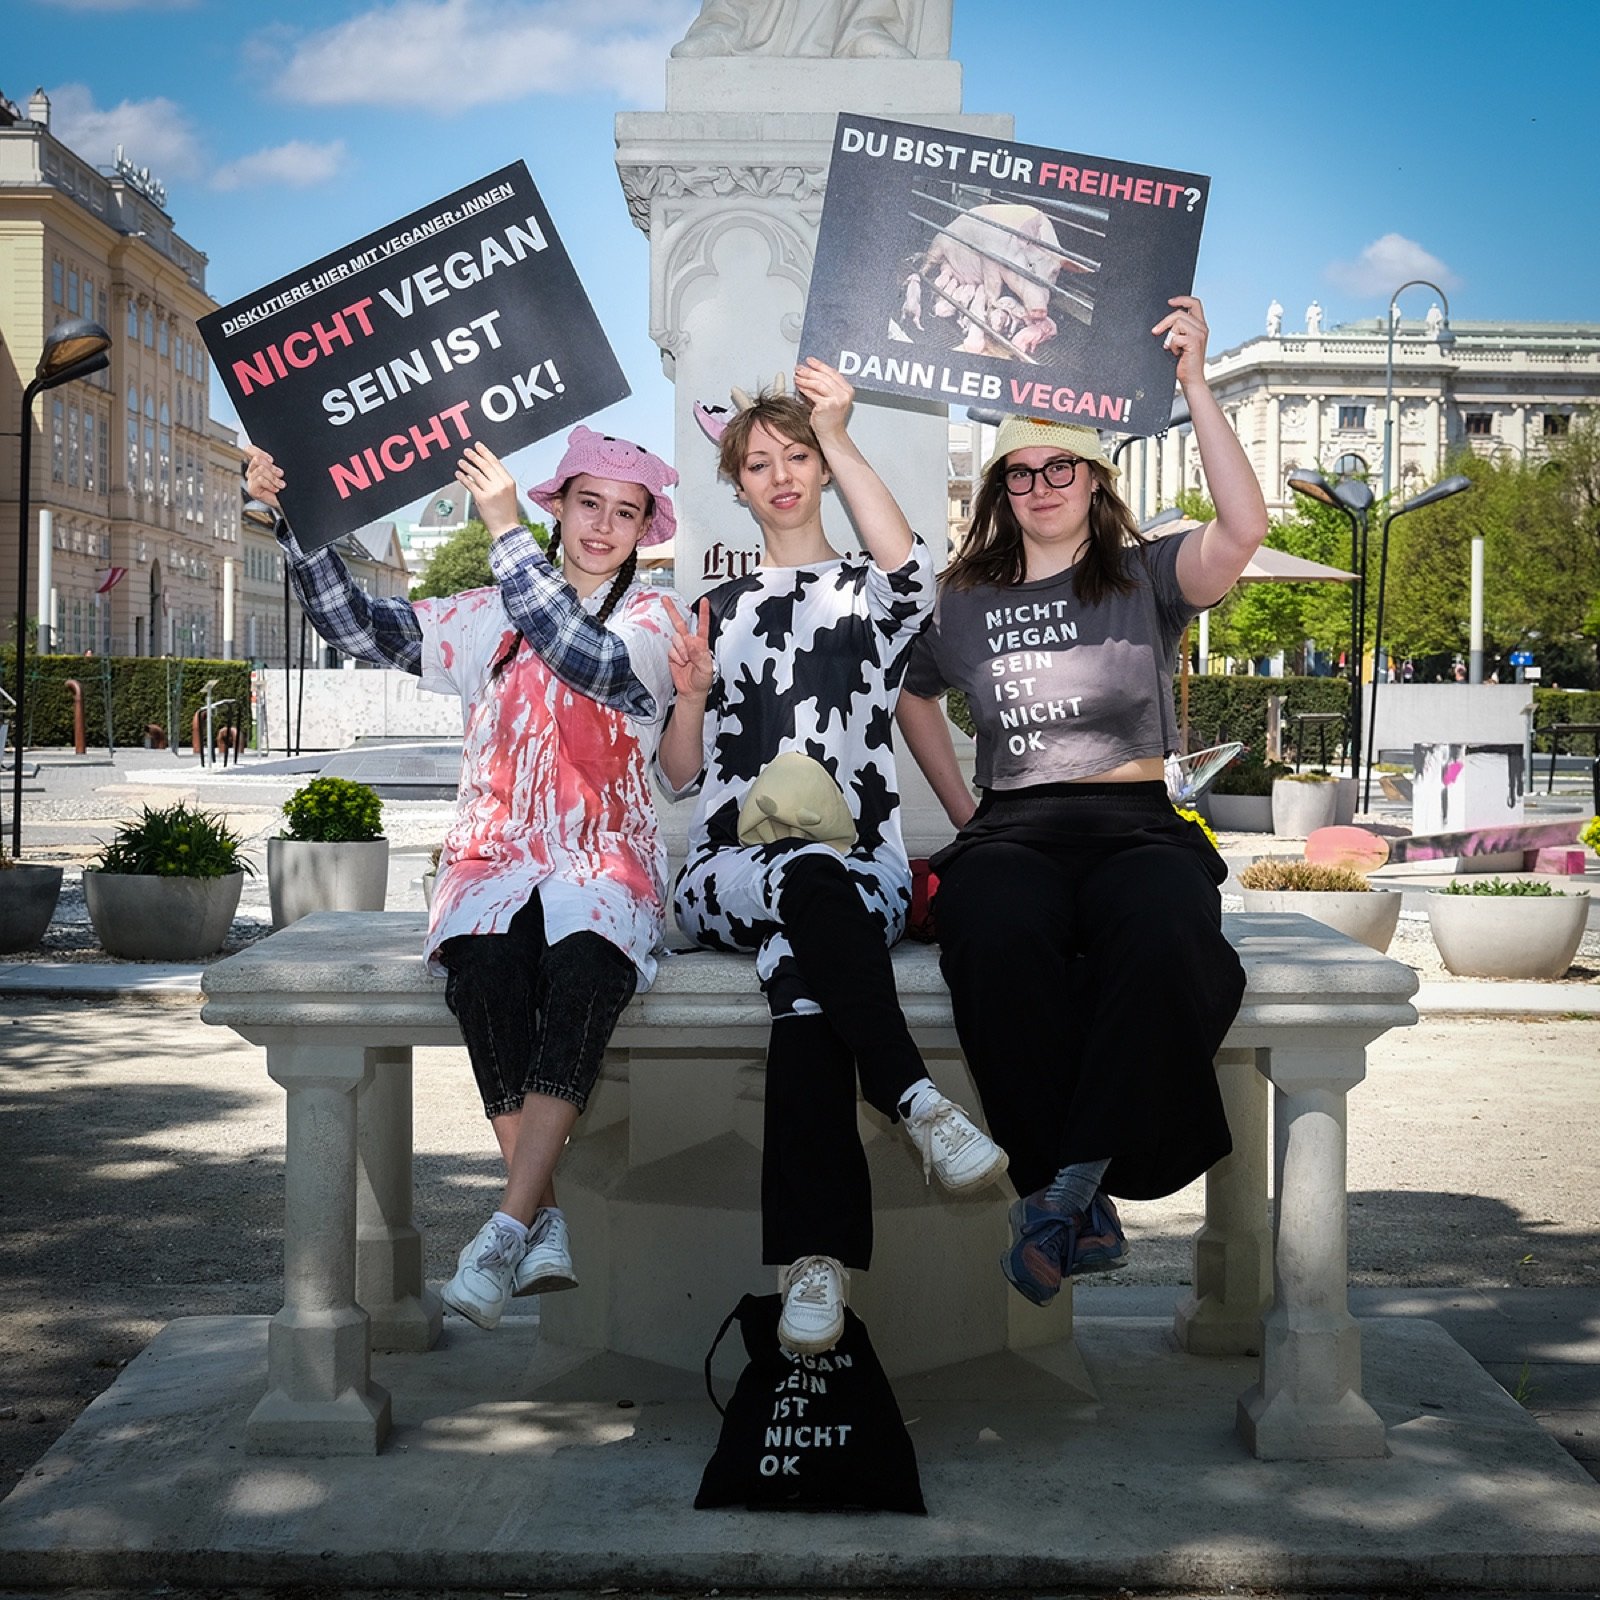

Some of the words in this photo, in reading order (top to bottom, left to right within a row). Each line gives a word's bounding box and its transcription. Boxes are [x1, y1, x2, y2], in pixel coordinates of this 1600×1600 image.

[841, 128, 888, 158] DU
[893, 137, 966, 171] BIST
[970, 149, 1033, 184] FÜR
[1038, 162, 1201, 212] FREIHEIT?
[221, 281, 311, 336] DISKUTIERE
[313, 264, 350, 291] HIER
[349, 248, 381, 272] MIT
[231, 297, 377, 397] NICHT
[379, 215, 548, 319] VEGAN
[322, 348, 432, 426] SEIN
[430, 310, 503, 373] IST
[838, 350, 934, 387] DANN
[940, 368, 1001, 400] LEB
[1010, 379, 1132, 423] VEGAN!
[328, 400, 472, 499] NICHT
[480, 359, 566, 423] OK!
[985, 600, 1067, 630] NICHT
[988, 621, 1078, 654] VEGAN
[991, 651, 1052, 677] SEIN
[994, 677, 1037, 702] IST
[1000, 697, 1082, 729] NICHT
[1008, 731, 1047, 756] OK
[772, 1396, 809, 1420] IST
[764, 1425, 852, 1448] NICHT
[759, 1455, 801, 1476] OK
